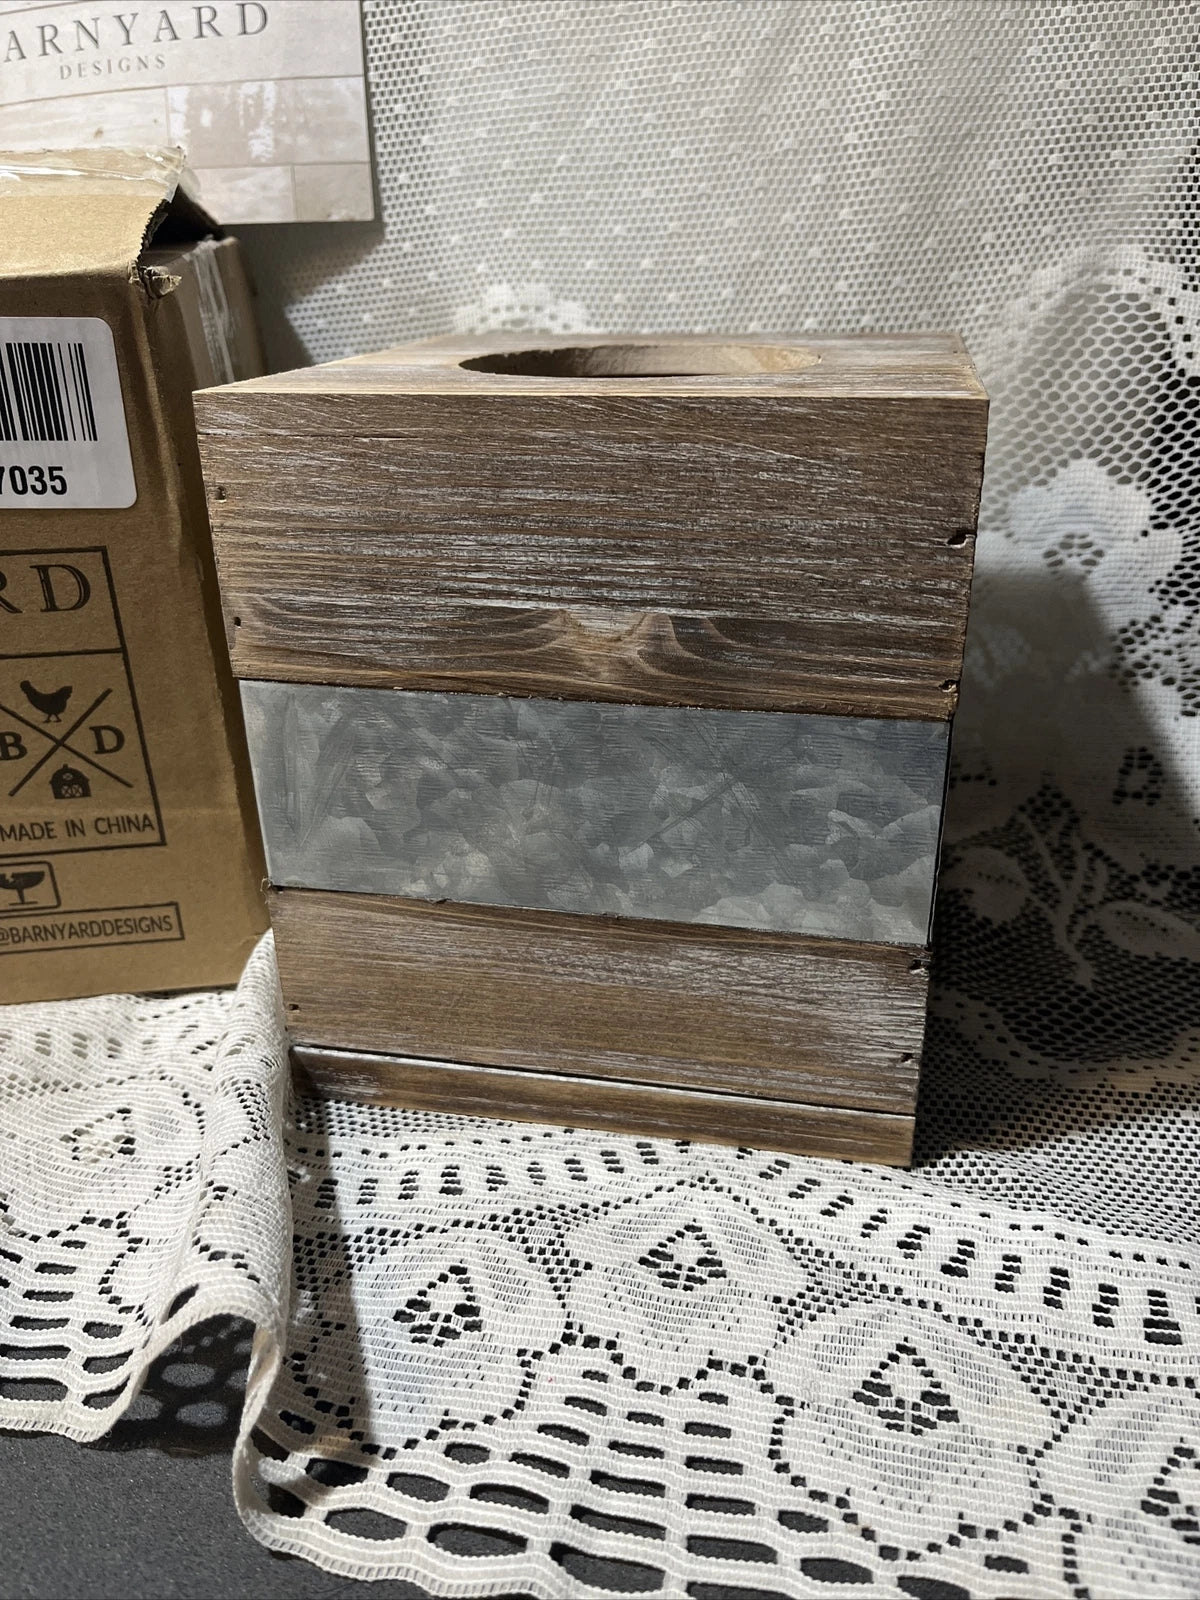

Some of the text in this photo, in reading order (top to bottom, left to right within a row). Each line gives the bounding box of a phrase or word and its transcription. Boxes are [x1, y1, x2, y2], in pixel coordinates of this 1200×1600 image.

[3, 2, 269, 63] ARNYARD
[59, 54, 166, 81] DESIGNS
[0, 724, 126, 761] B D
[0, 813, 155, 842] MADE IN CHINA
